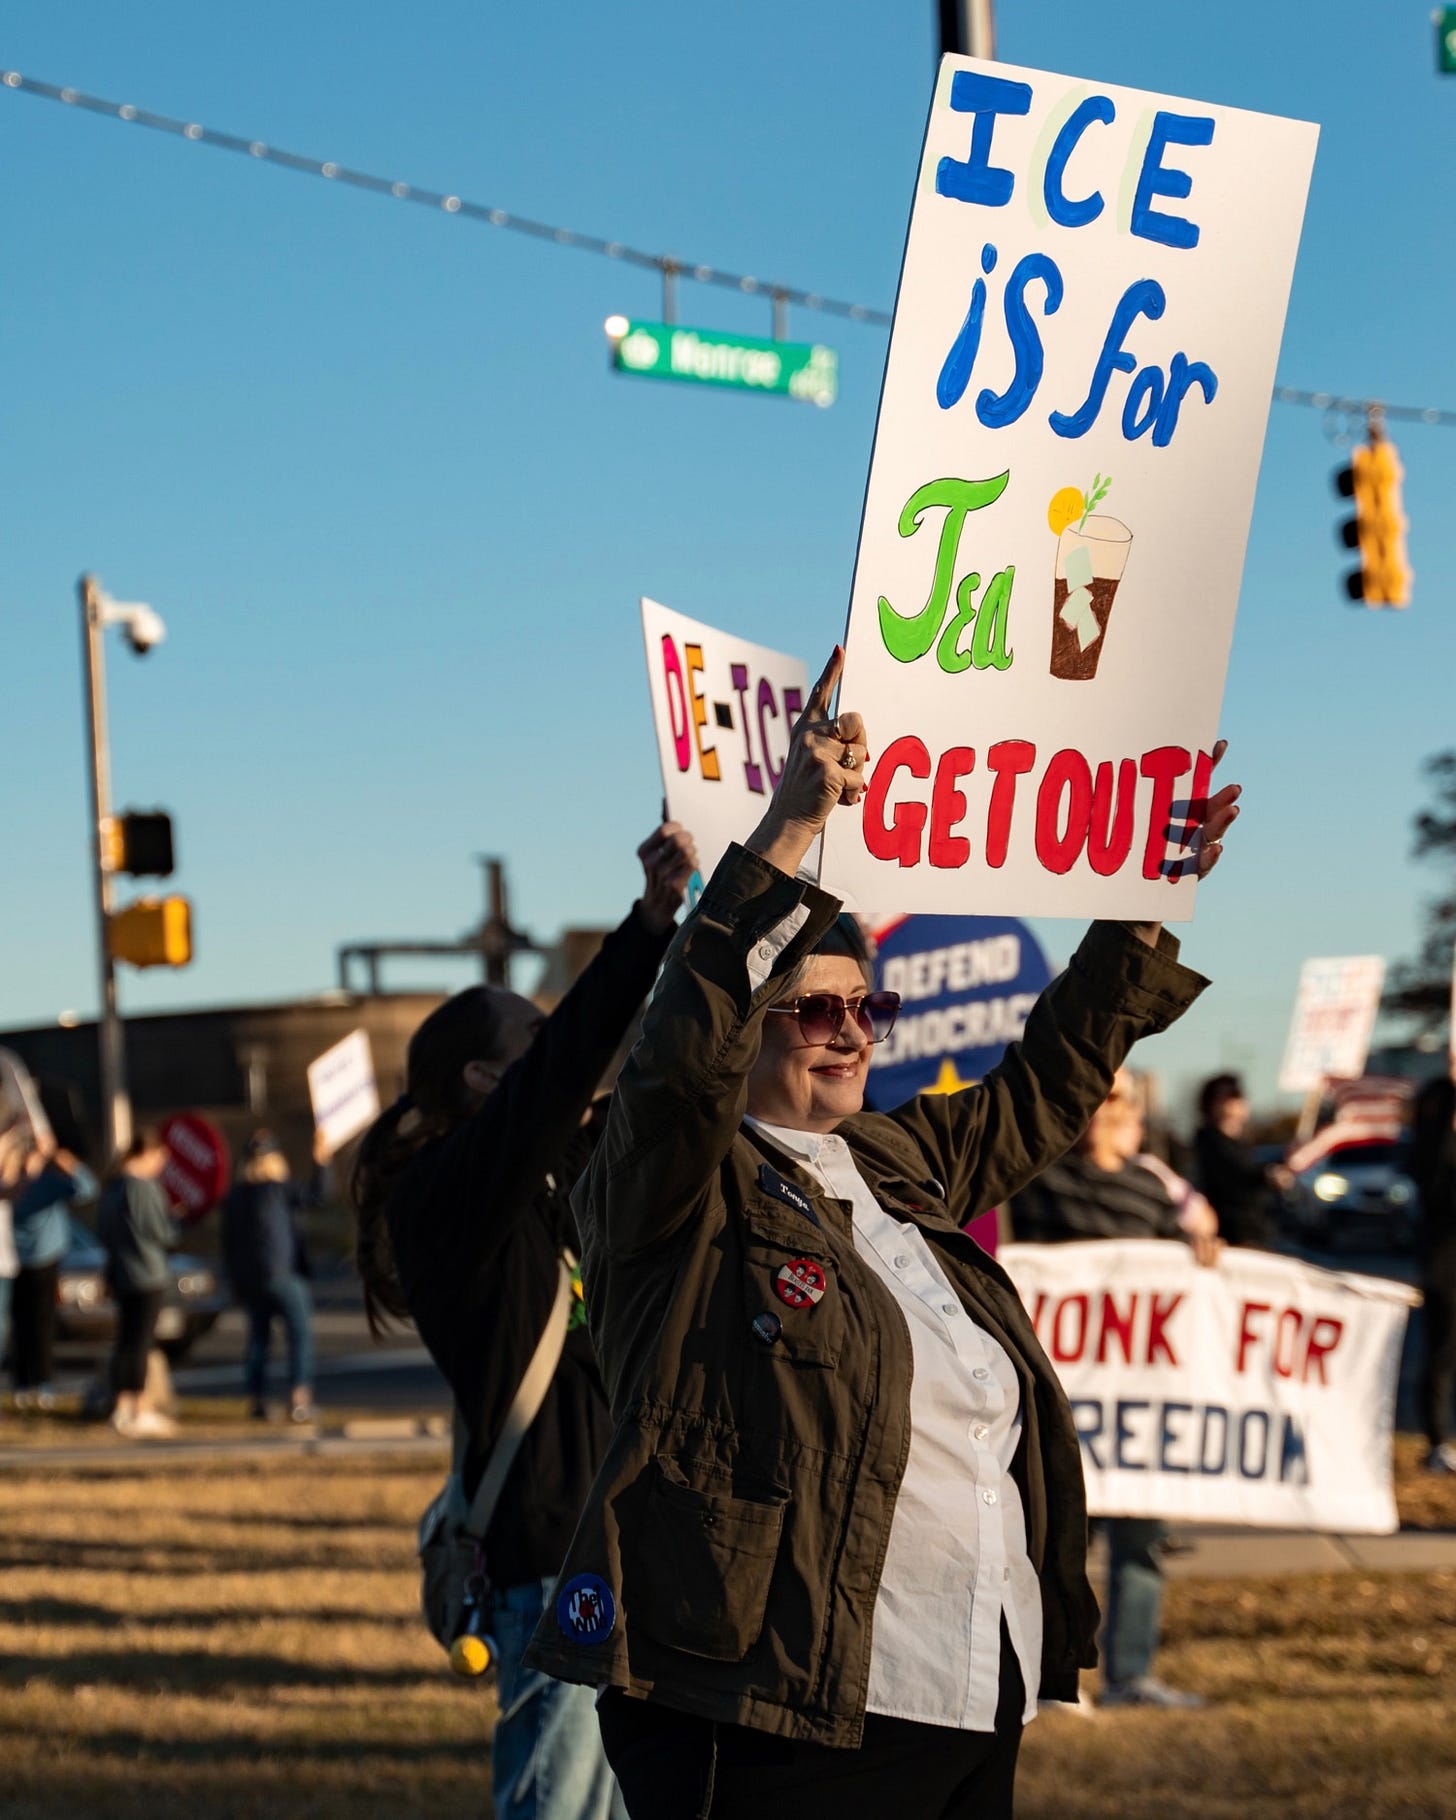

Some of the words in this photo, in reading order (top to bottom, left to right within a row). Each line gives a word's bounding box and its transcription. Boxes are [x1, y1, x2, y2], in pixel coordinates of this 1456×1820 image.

[936, 70, 1215, 249] ICE
[1048, 279, 1218, 447] for
[878, 468, 1015, 673] Tea
[884, 935, 1021, 1001] DEFEND
[780, 1183, 810, 1212] Tonya
[1236, 1302, 1344, 1386] FOR
[1071, 1399, 1310, 1484] REEDOM
